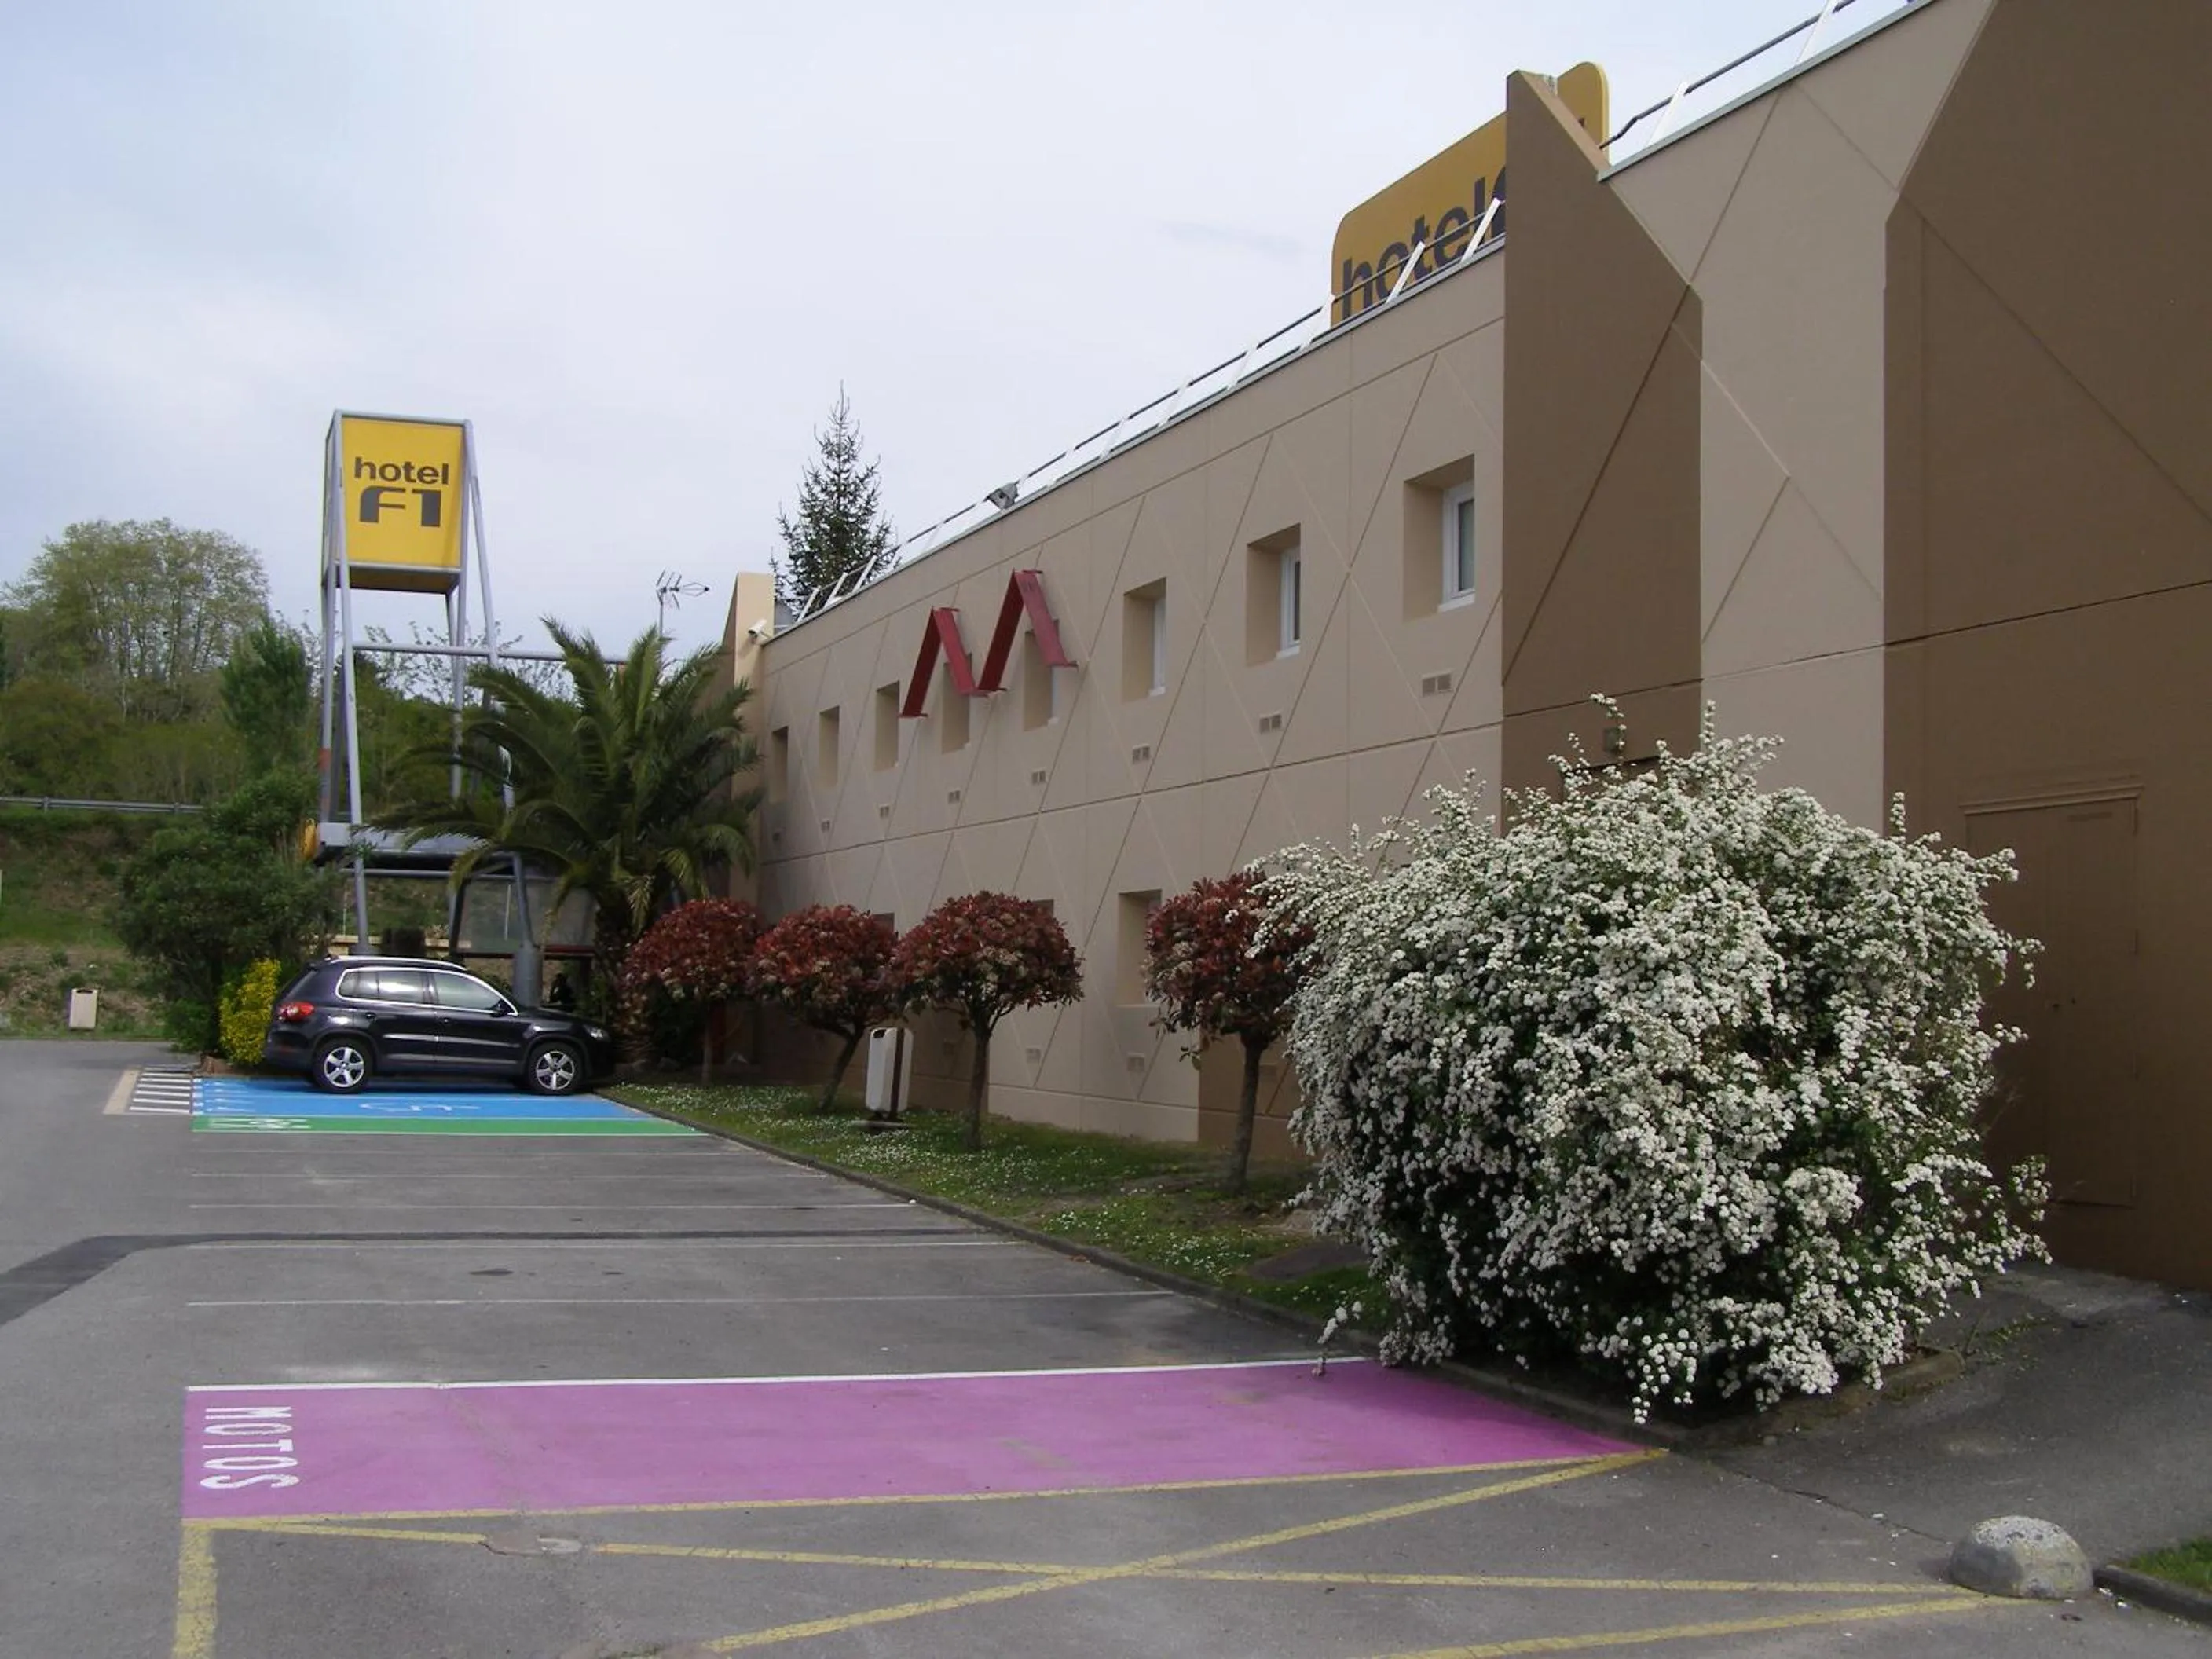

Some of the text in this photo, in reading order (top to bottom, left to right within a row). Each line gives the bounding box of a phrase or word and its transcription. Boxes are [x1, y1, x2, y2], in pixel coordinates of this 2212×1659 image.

[354, 456, 449, 485] hotel
[360, 485, 441, 527] F1
[200, 1406, 300, 1489] MOTOS
